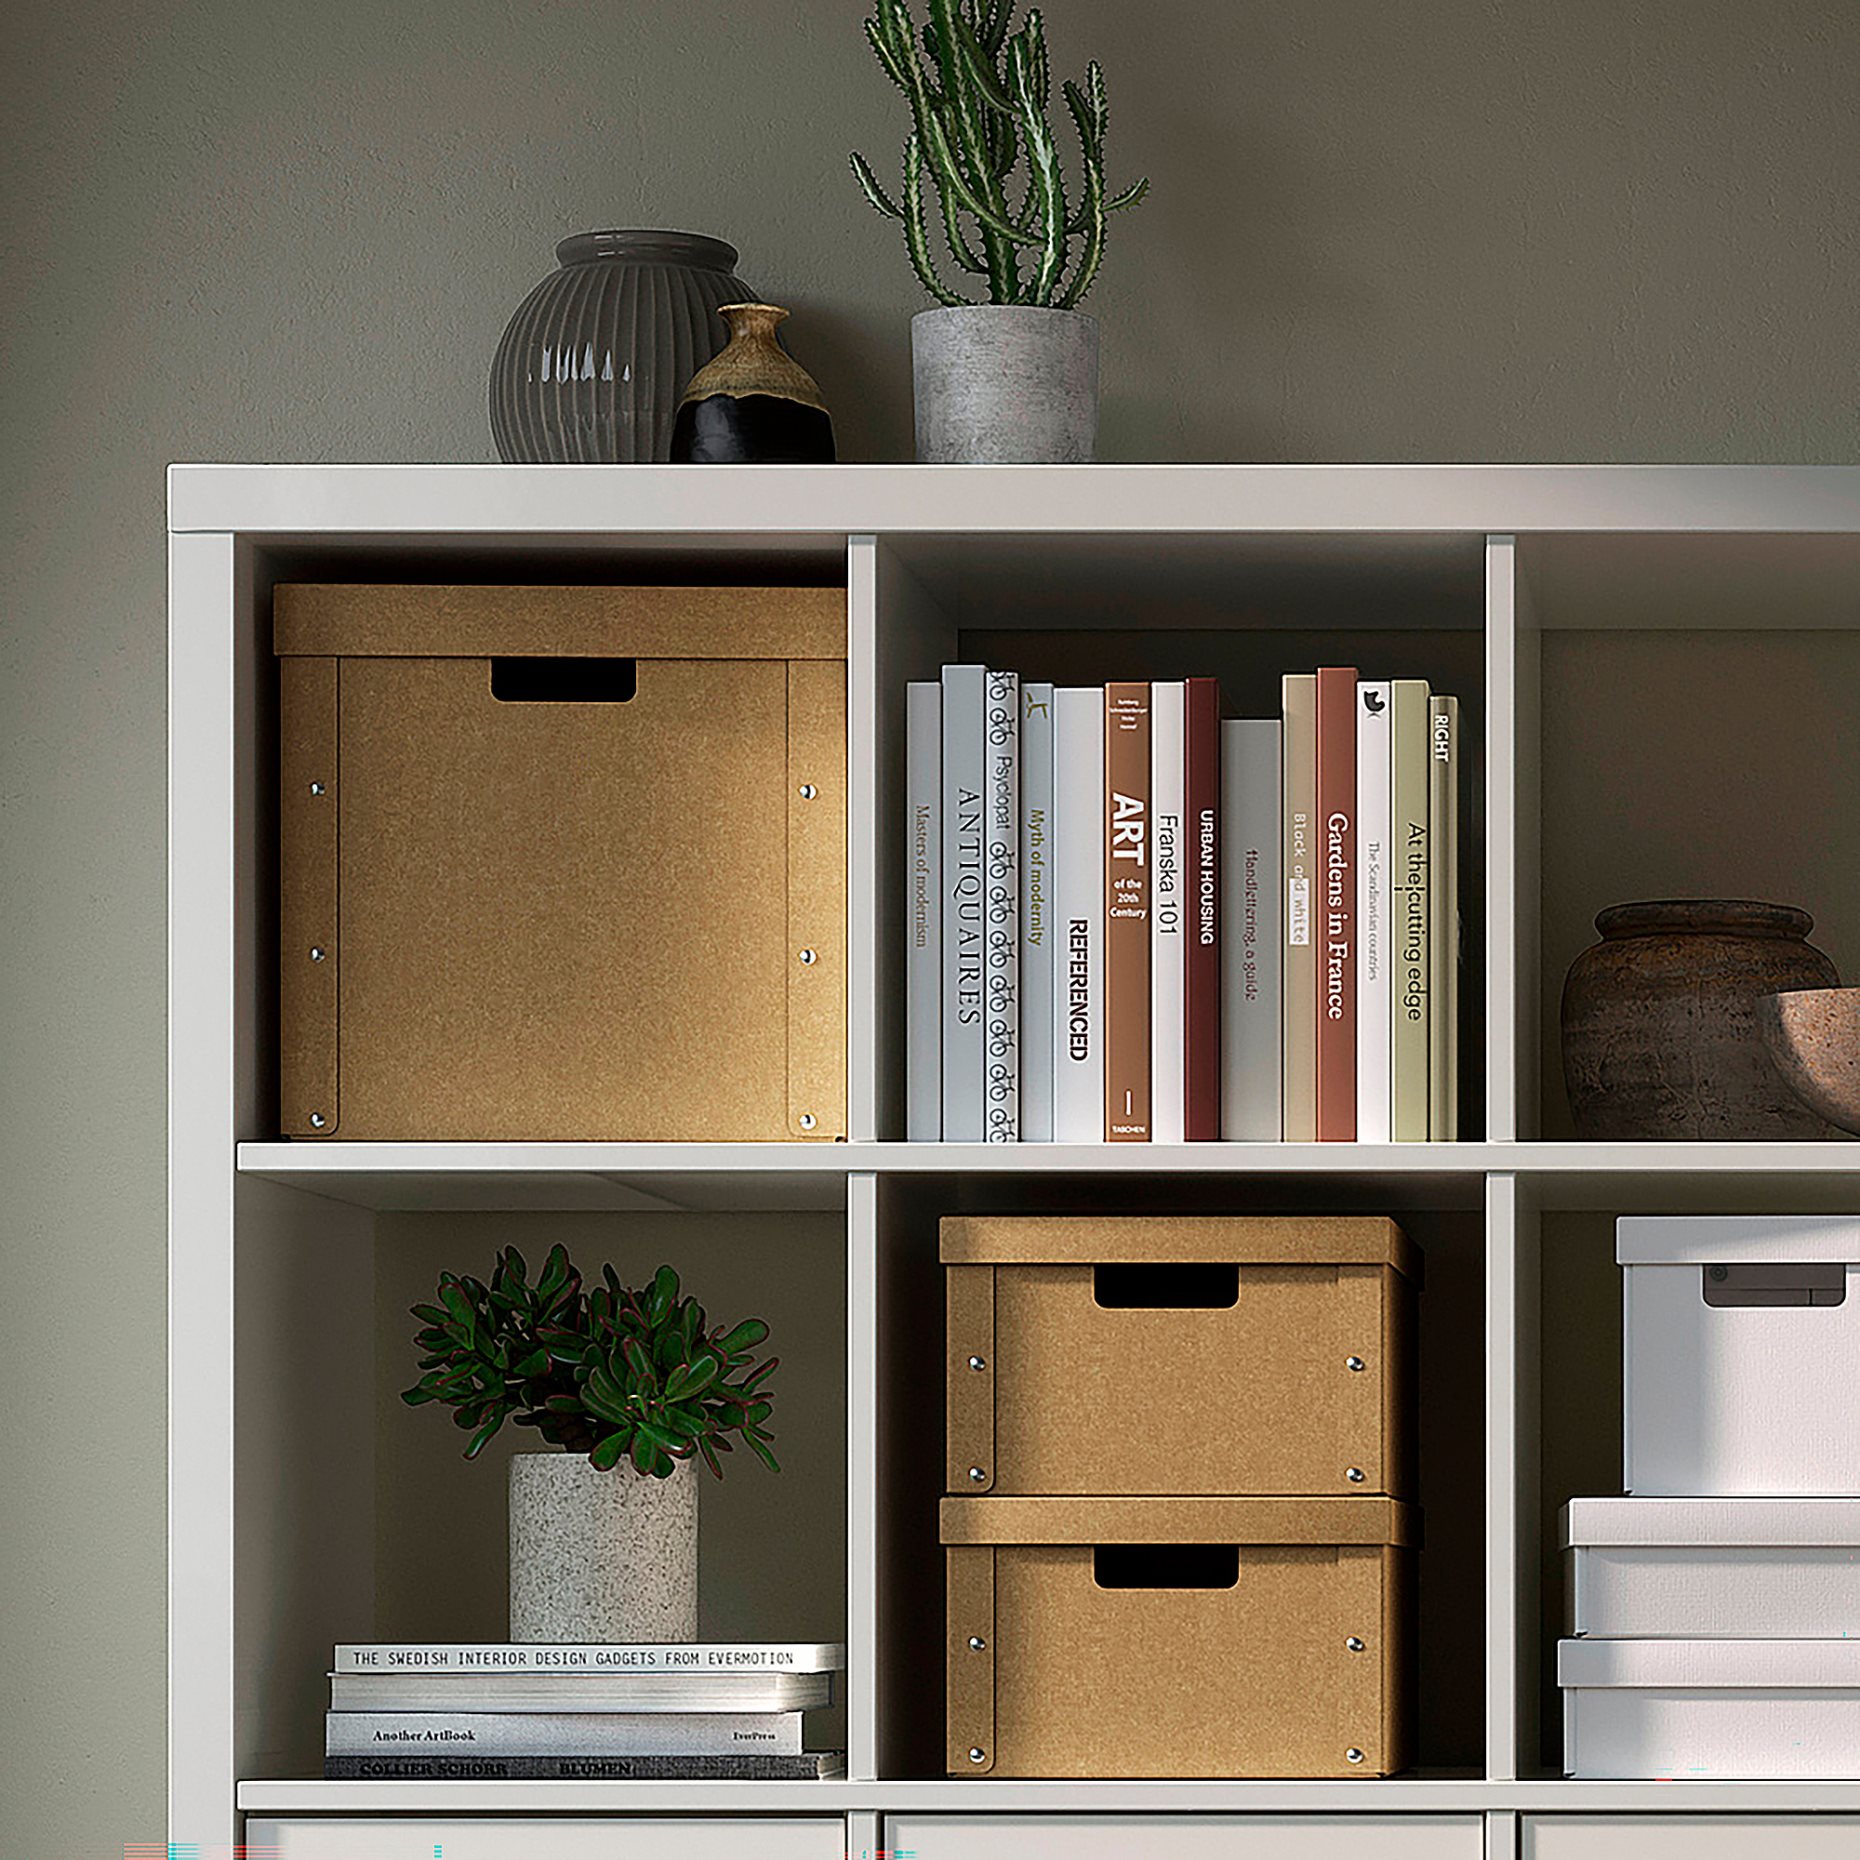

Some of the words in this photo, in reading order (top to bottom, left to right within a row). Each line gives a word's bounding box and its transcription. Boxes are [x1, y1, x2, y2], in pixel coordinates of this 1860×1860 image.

[1434, 714, 1449, 762] RIGHT
[916, 805, 930, 855] Masters
[1028, 809, 1045, 851] Myth
[1112, 792, 1144, 866] ART
[1200, 810, 1214, 867] URBAN
[1293, 813, 1307, 857] Black
[1408, 822, 1426, 847] At
[916, 861, 930, 874] of
[1031, 851, 1045, 866] of
[1159, 815, 1178, 893] Franska
[1328, 812, 1349, 908] Gardens
[1368, 841, 1380, 861] The
[1408, 853, 1427, 885] the
[1113, 879, 1125, 889] of
[1126, 879, 1142, 889] the
[1117, 893, 1139, 903] 20th
[1293, 865, 1306, 892] and
[1368, 863, 1380, 931] Scandinavian
[916, 875, 930, 948] modernism
[953, 788, 981, 1024] ANTIQUAIRES
[1028, 869, 1045, 946] modernity
[1110, 906, 1147, 920] Century
[1159, 900, 1178, 934] 101
[1200, 870, 1214, 945] HOUSING
[1293, 900, 1306, 943] white
[1328, 912, 1349, 936] in
[1403, 891, 1426, 962] cutting
[1245, 950, 1254, 959] a
[1368, 933, 1380, 981] countries
[1069, 919, 1088, 1061] REFERENCED
[1243, 962, 1258, 1001] guide
[1328, 941, 1349, 1020] France
[1403, 967, 1427, 1020] edge
[353, 1652, 379, 1665] THE
[388, 1652, 449, 1665] SWEDISH
[458, 1652, 527, 1665] INTERIOR
[535, 1652, 588, 1665] DESIGN
[595, 1652, 656, 1665] GADGETS
[665, 1652, 700, 1665] FROM
[708, 1652, 794, 1665] EVERMOTION
[373, 1730, 422, 1742] Another
[424, 1730, 476, 1742] ArtBook
[359, 1763, 432, 1776] COLLIER
[438, 1763, 508, 1776] SCHORR
[559, 1763, 631, 1776] BLUMEN
